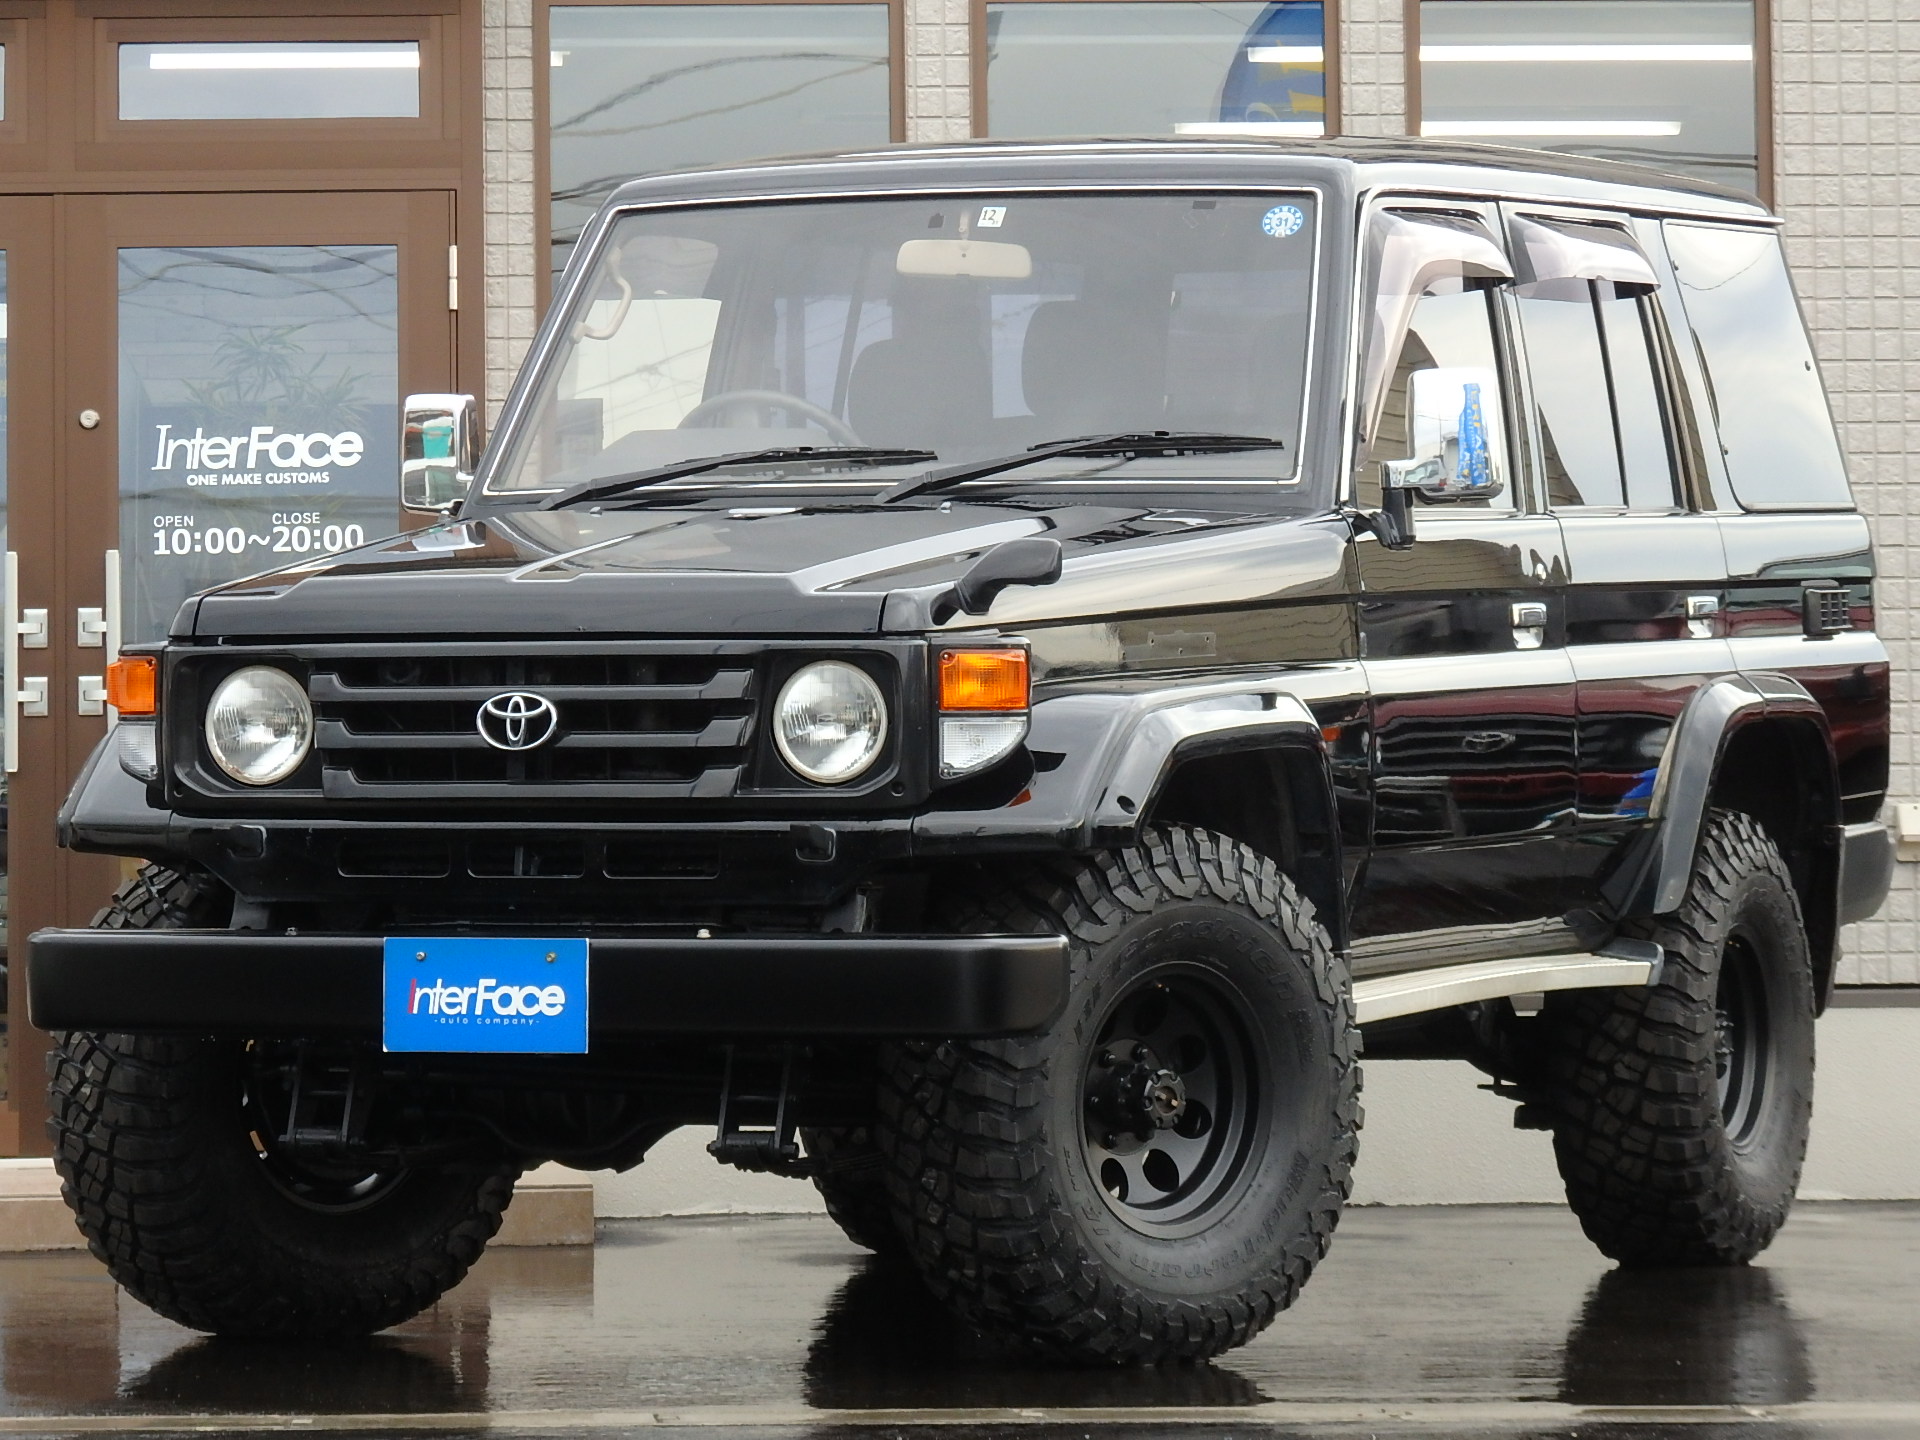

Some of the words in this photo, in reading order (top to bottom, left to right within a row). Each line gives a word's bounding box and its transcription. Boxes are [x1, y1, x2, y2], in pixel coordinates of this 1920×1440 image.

[981, 209, 997, 220] 12
[1275, 217, 1289, 227] 31
[151, 424, 364, 470] InterFace
[186, 473, 218, 486] ONE
[221, 472, 262, 485] MAKE
[265, 471, 330, 484] CUSTOMS
[153, 515, 194, 527] OPEN
[272, 512, 320, 525] CLOSE
[408, 978, 566, 1016] InterFace
